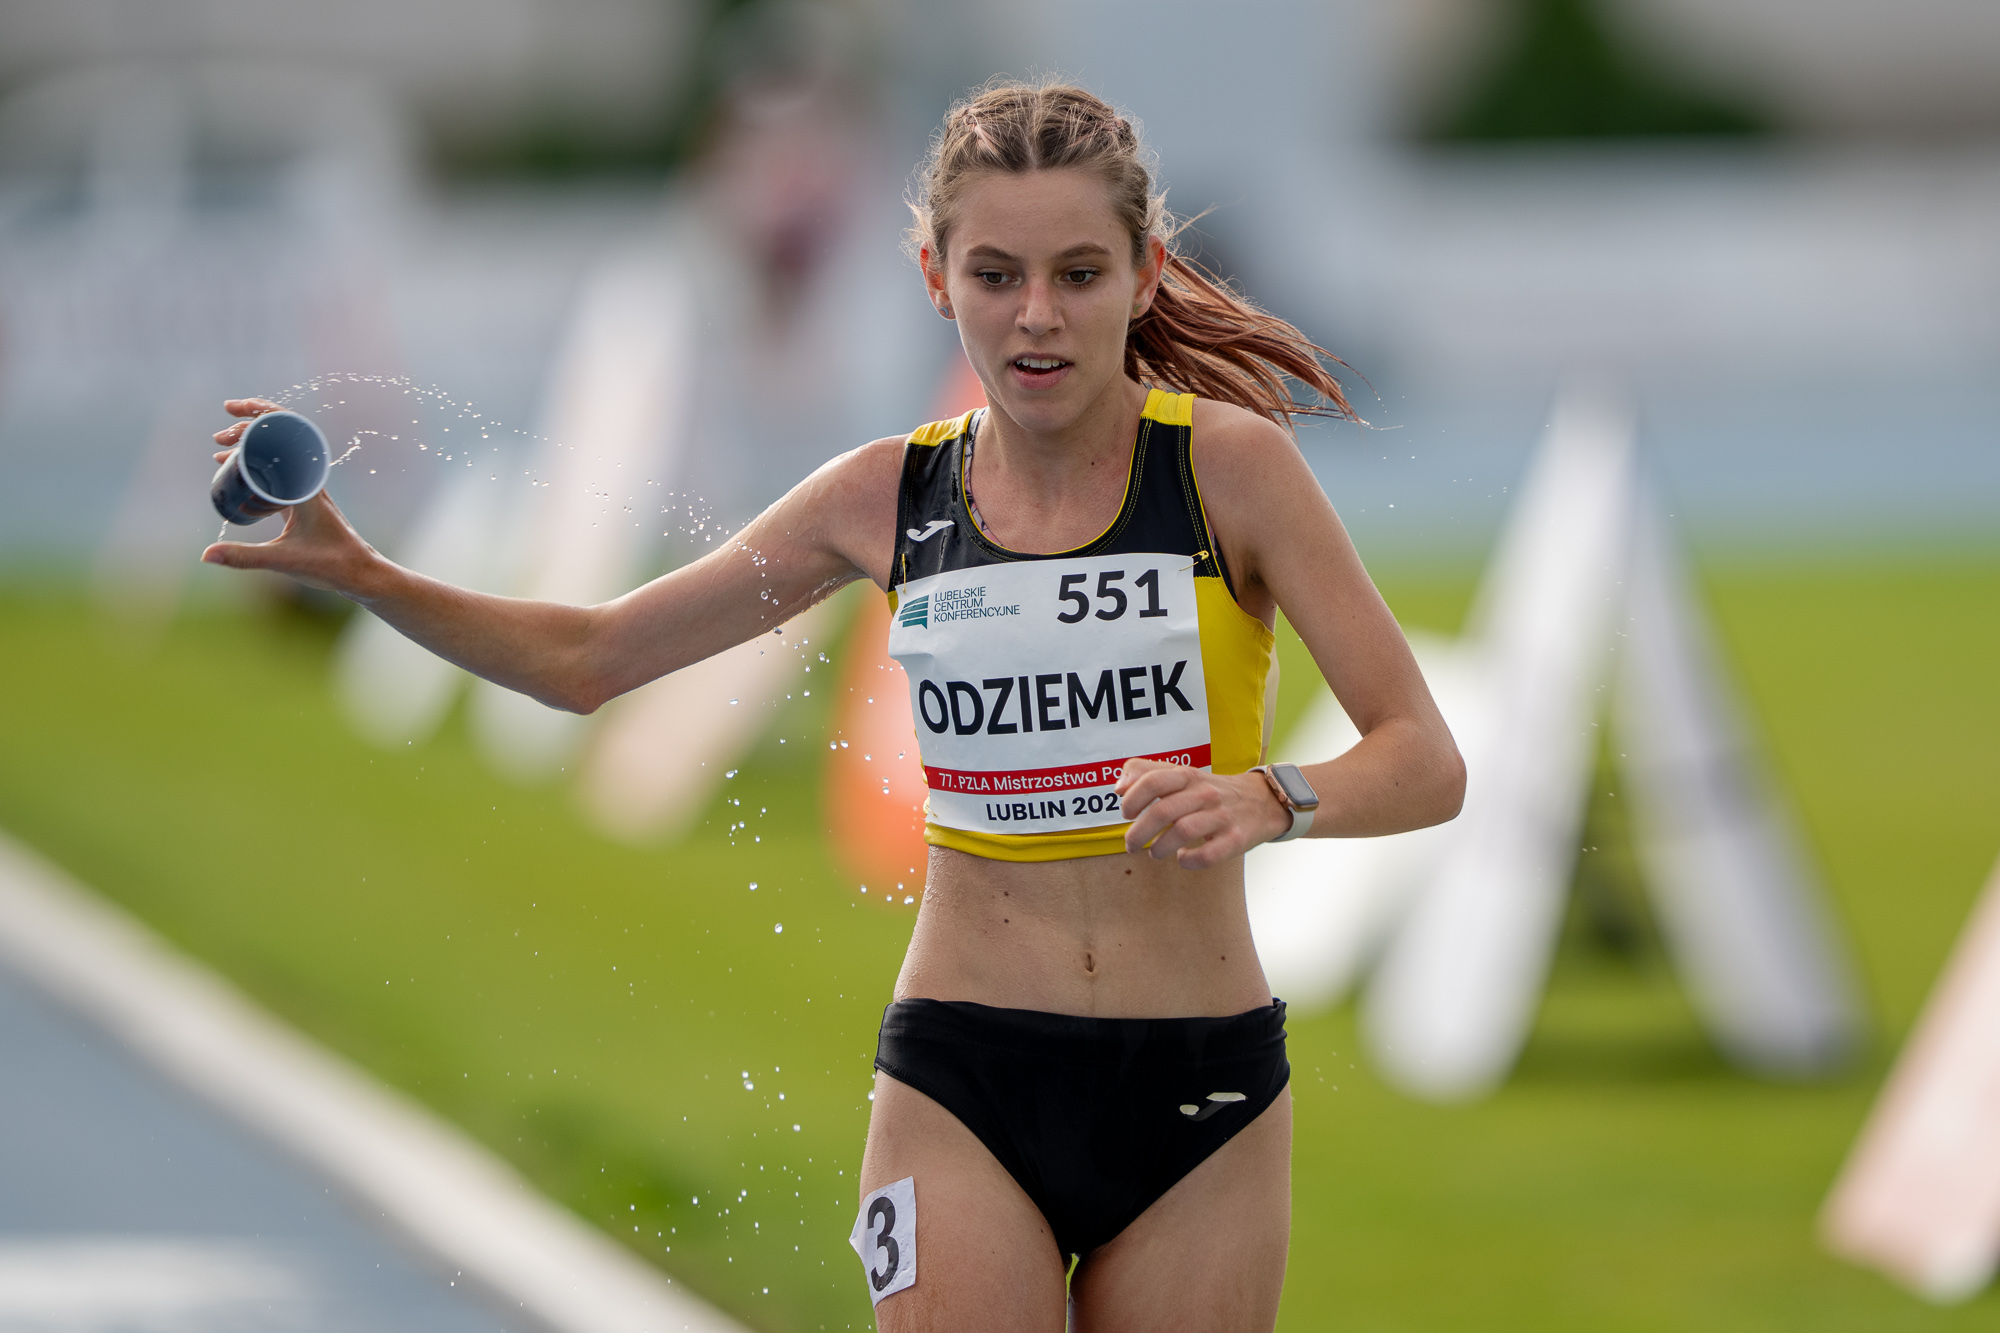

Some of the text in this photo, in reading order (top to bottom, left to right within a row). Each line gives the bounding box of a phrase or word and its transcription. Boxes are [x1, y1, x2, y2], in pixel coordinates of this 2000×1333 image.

[934, 586, 986, 602] LUBELSKIE
[934, 598, 983, 612] CENTRUM
[1057, 569, 1168, 624] 551
[934, 605, 1020, 623] KONFERENCYJNE
[919, 660, 1194, 735] ODZIEMEK
[958, 776, 991, 790] PZLA
[994, 771, 1097, 790] Mistrzostwa
[986, 792, 1122, 821] LUBLIN 202
[867, 1196, 899, 1292] 3
